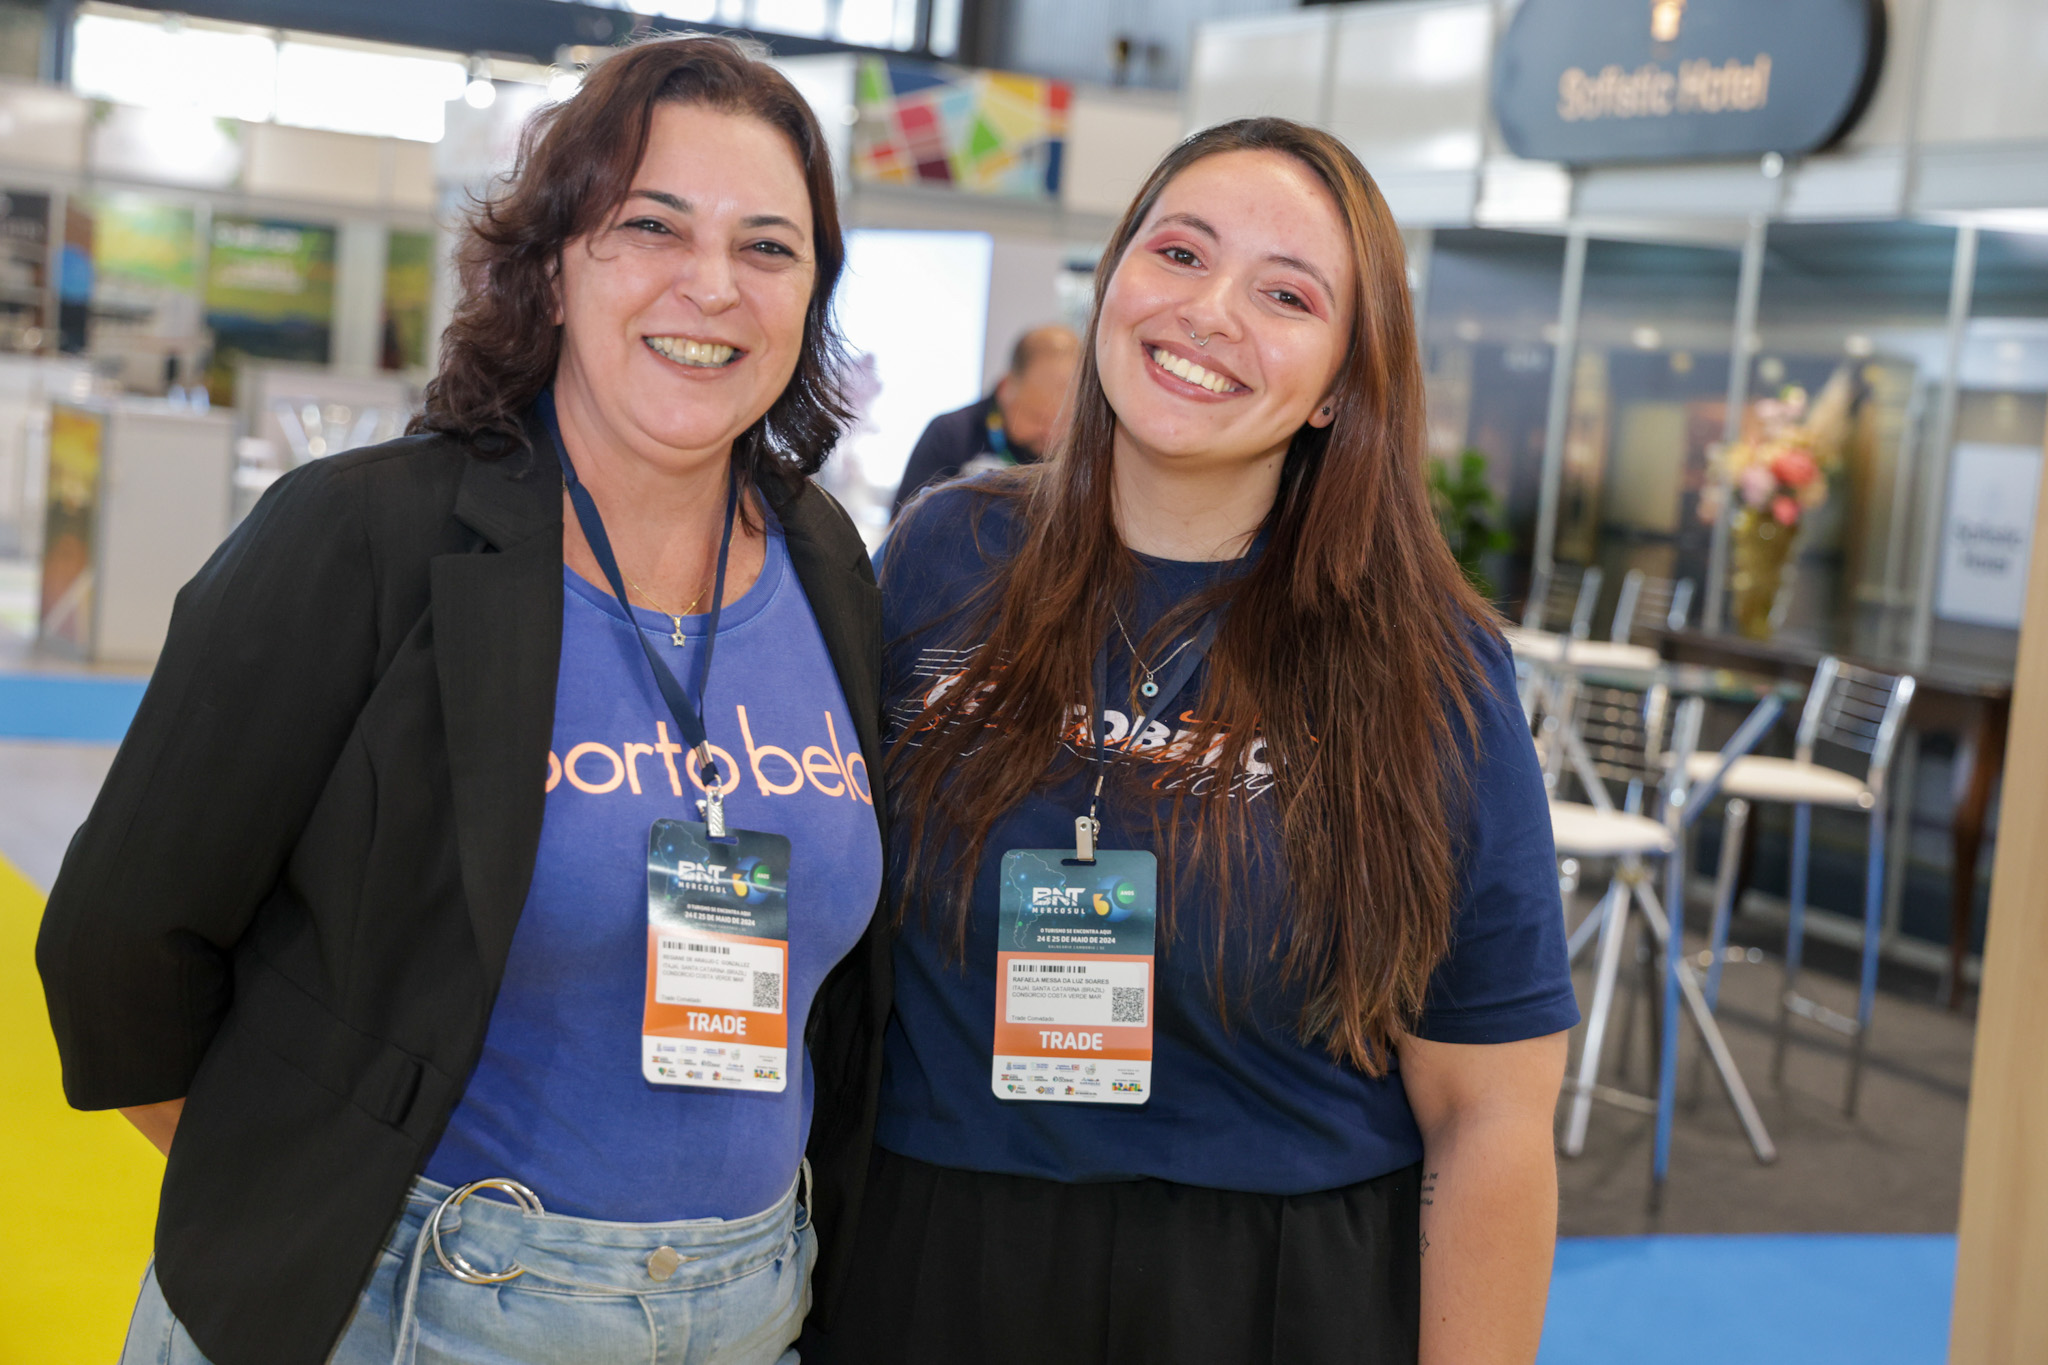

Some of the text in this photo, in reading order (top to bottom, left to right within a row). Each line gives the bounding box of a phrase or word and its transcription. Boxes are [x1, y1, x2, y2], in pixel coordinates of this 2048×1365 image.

[1678, 52, 1772, 112] Hotel
[678, 861, 727, 884] BNT
[678, 882, 727, 894] MERCOSUL
[1033, 887, 1085, 906] BNT
[699, 912, 706, 920] 25
[716, 915, 731, 923] MAIO
[741, 918, 755, 926] 2024
[688, 1012, 746, 1035] TRADE
[1039, 1031, 1103, 1050] TRADE
